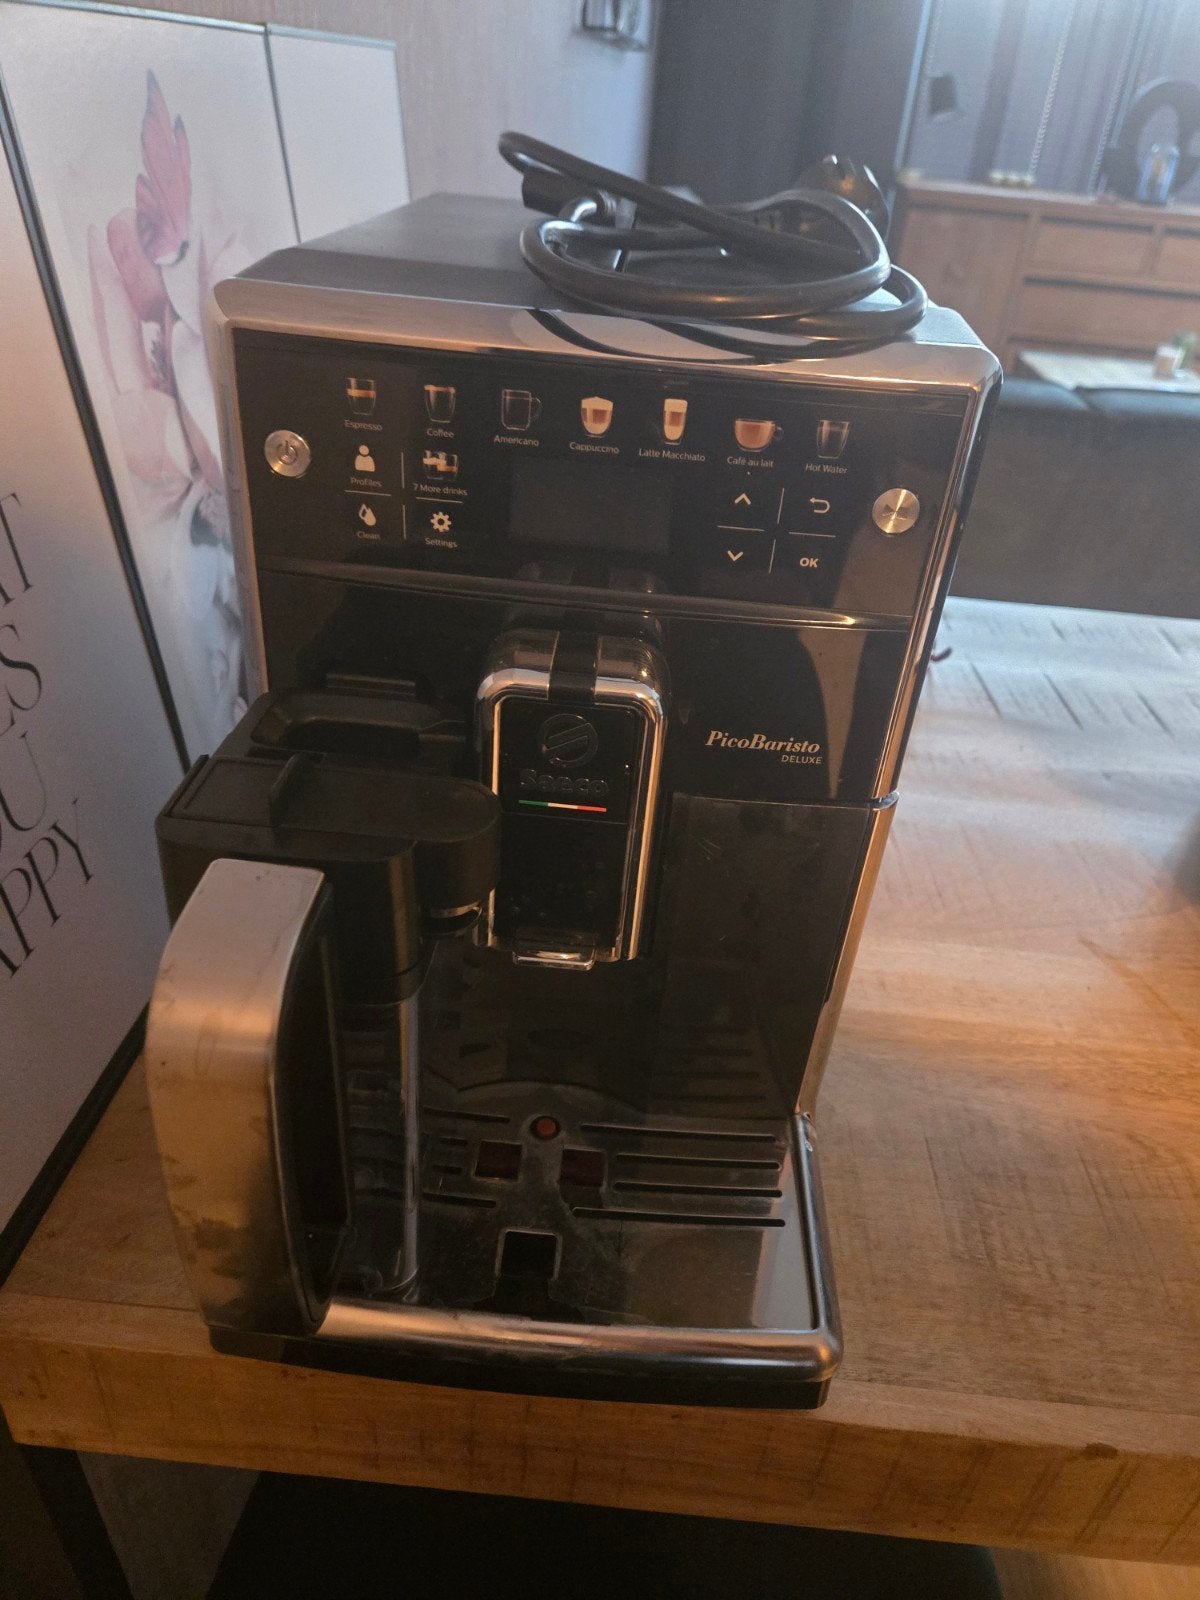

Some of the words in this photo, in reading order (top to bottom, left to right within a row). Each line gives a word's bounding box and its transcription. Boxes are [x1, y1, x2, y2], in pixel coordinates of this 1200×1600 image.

[344, 419, 383, 432] Espresso
[426, 428, 455, 439] Coffee
[493, 435, 540, 447] Americano
[569, 441, 620, 455] Cappuccino
[638, 448, 661, 459] Latte
[662, 450, 706, 462] Macchiato
[726, 456, 747, 467] Café
[748, 459, 759, 467] au
[760, 458, 774, 468] lait
[805, 463, 819, 473] Hot
[820, 464, 848, 475] Water
[350, 477, 383, 488] Profiles
[413, 483, 419, 491] 7
[420, 484, 441, 495] More
[443, 485, 468, 497] drinks
[356, 530, 381, 541] Clean
[425, 537, 458, 549] Settings
[800, 557, 819, 569] OK
[705, 729, 820, 754] PicoBaristo
[781, 754, 823, 765] DELUXE
[0, 798, 93, 978] PPY
